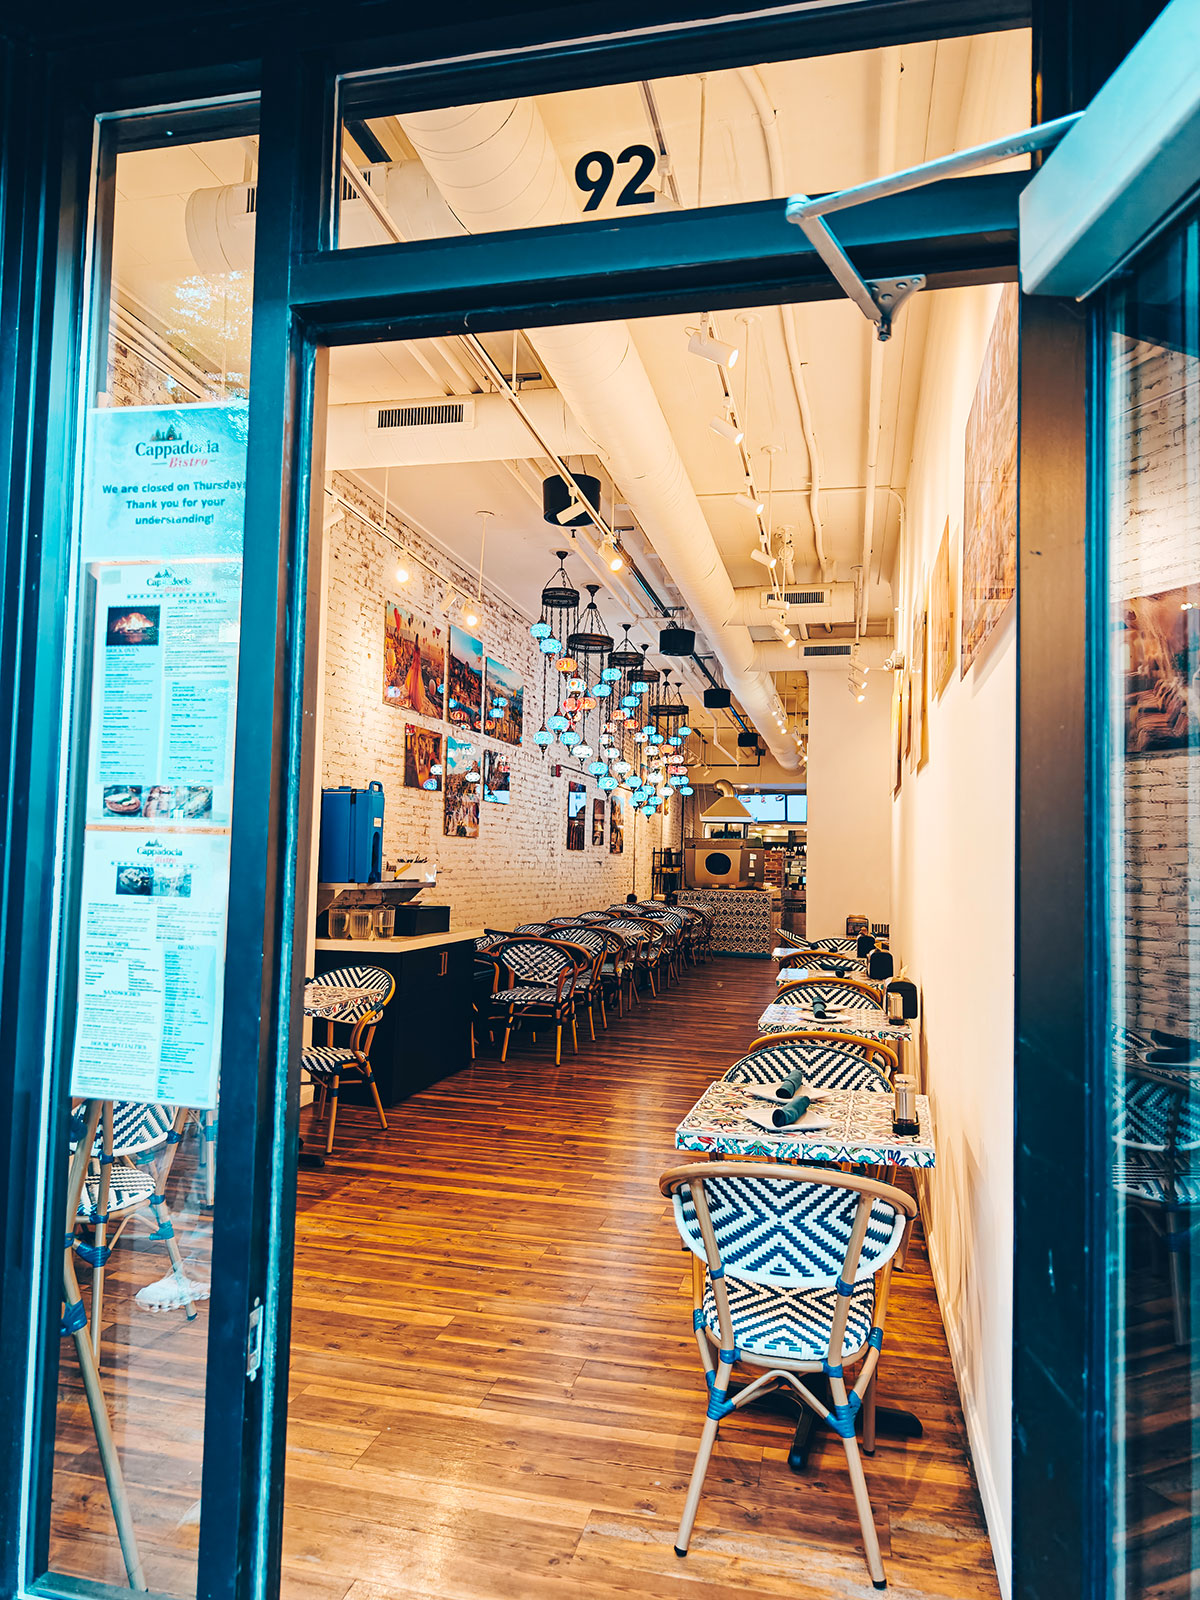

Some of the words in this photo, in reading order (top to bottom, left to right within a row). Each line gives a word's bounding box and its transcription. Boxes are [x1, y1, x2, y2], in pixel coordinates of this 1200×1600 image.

[575, 144, 656, 212] 92
[135, 440, 219, 459] Cappadoia
[168, 457, 208, 468] Bistro
[102, 484, 118, 494] We
[121, 485, 139, 493] are
[142, 482, 174, 493] closed
[177, 484, 190, 492] on
[126, 500, 157, 510] Thank
[161, 500, 179, 511] you
[182, 498, 198, 508] for
[201, 498, 226, 509] your
[135, 513, 214, 526] understanding!
